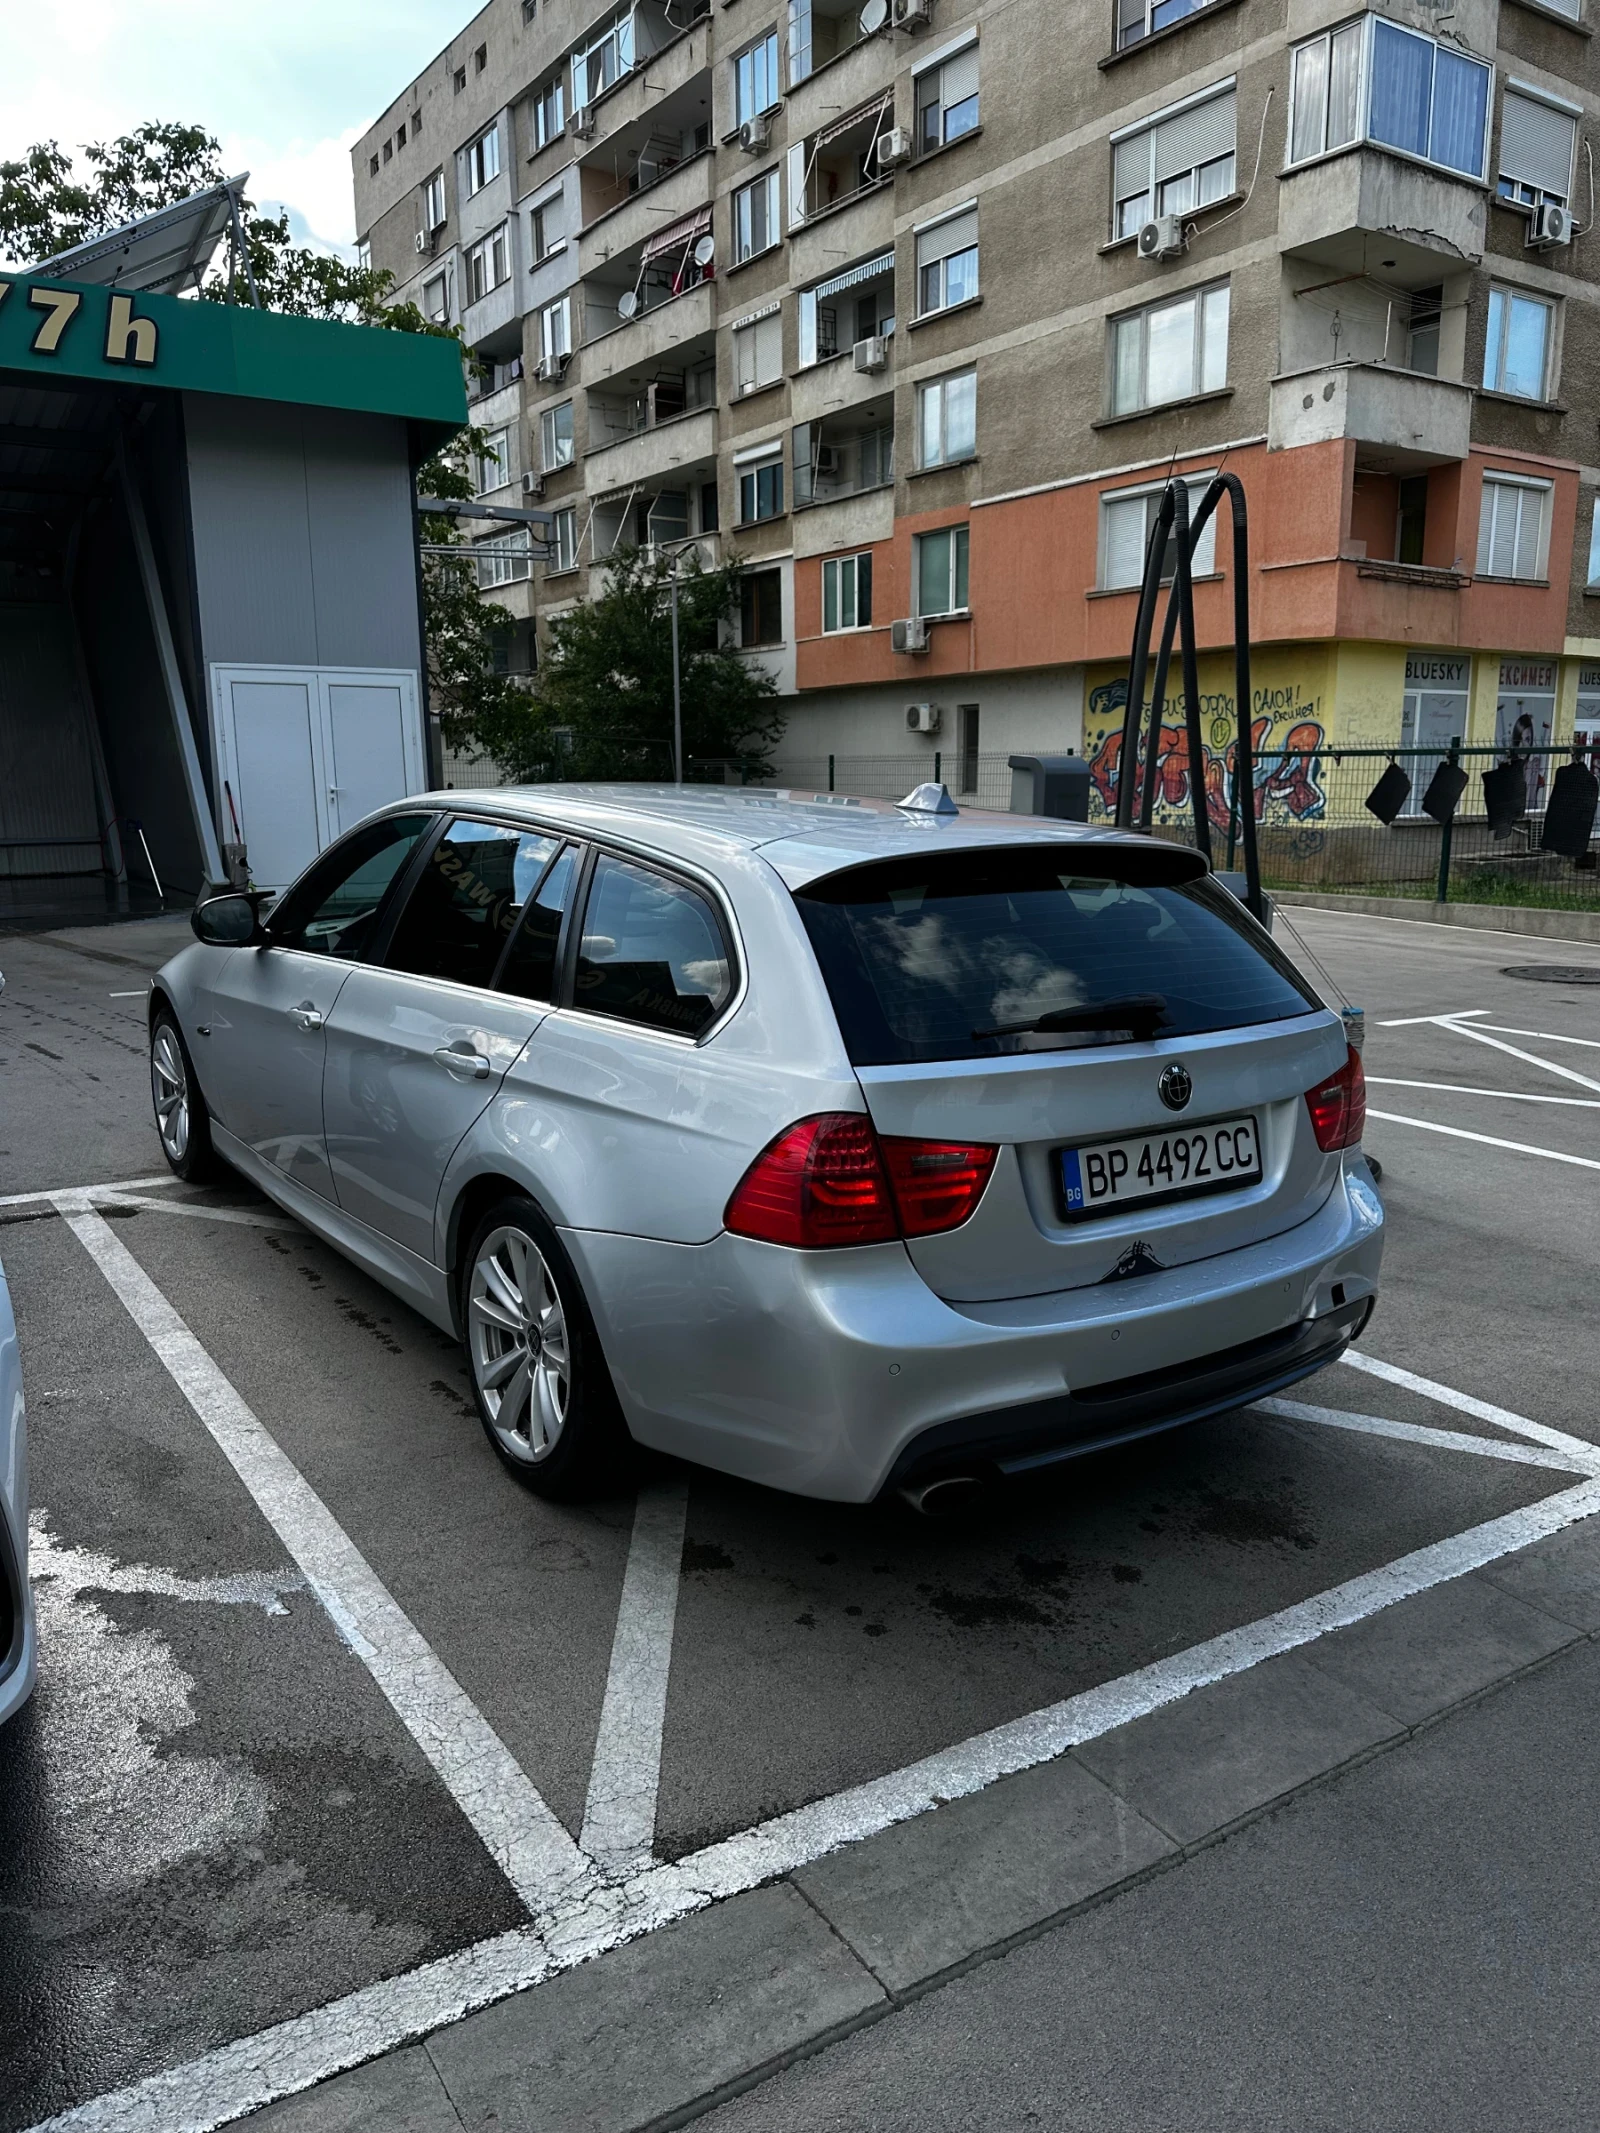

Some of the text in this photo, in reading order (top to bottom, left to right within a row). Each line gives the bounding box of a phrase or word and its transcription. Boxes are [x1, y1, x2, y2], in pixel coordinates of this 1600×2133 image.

[0, 282, 158, 364] 7 h
[1405, 661, 1464, 681] BLUESKY
[1499, 665, 1552, 687] ЕКСИМЕЯ
[1579, 671, 1600, 686] LUES
[1163, 1065, 1189, 1082] BMW
[1085, 1126, 1252, 1198] BP 4492 CC
[1066, 1187, 1082, 1202] BG
